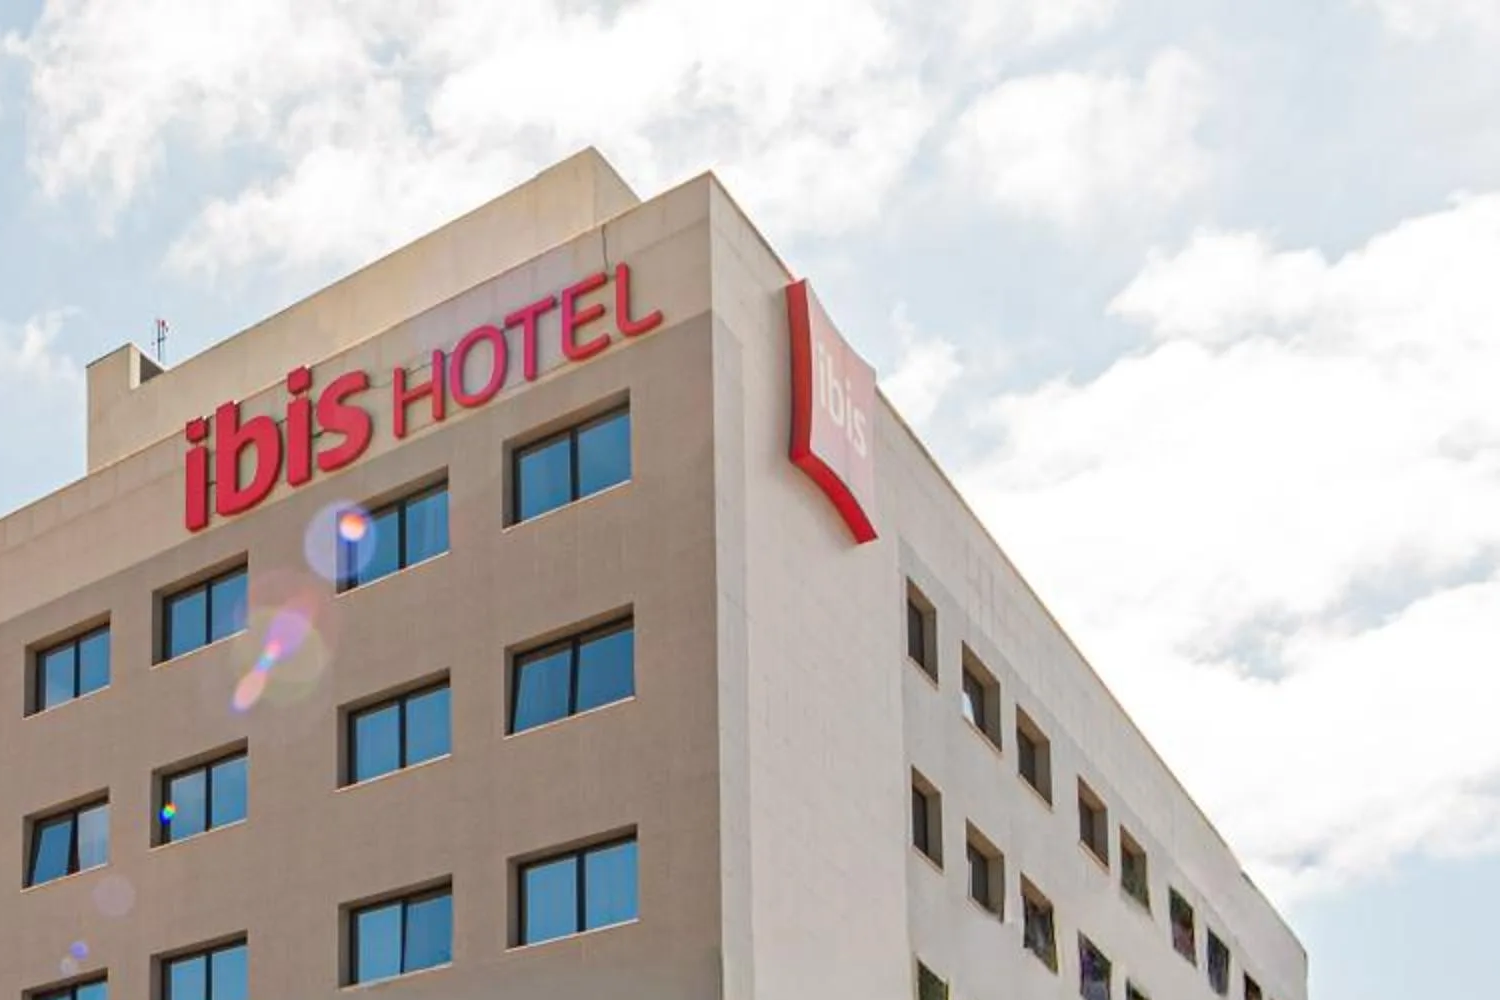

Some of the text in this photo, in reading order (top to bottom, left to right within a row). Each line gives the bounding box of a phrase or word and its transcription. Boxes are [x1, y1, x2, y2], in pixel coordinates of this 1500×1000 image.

[185, 261, 664, 533] ibis HOTEL
[817, 340, 868, 460] ibis
